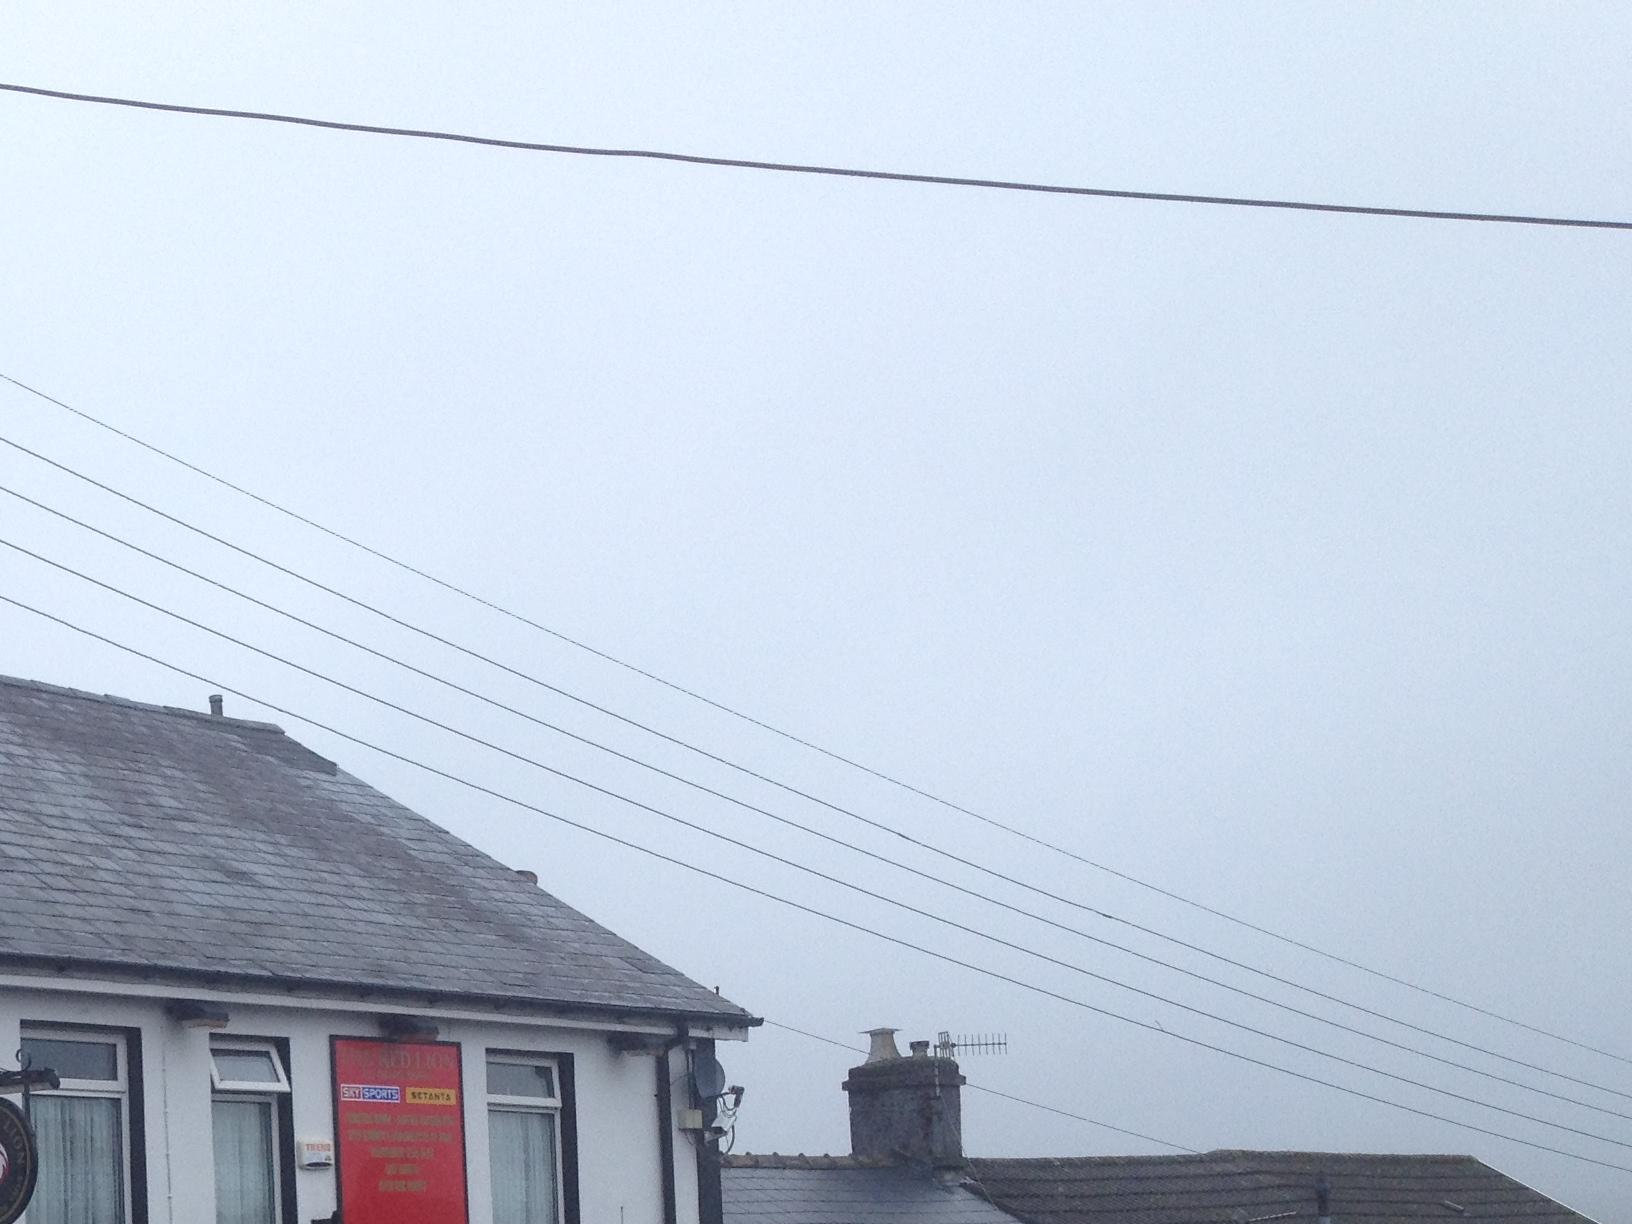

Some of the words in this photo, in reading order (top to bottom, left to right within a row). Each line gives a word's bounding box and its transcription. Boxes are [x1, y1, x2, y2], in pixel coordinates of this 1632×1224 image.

[342, 1087, 360, 1098] SKY
[363, 1088, 399, 1100] SPORTS
[410, 1091, 452, 1102] SETANTA
